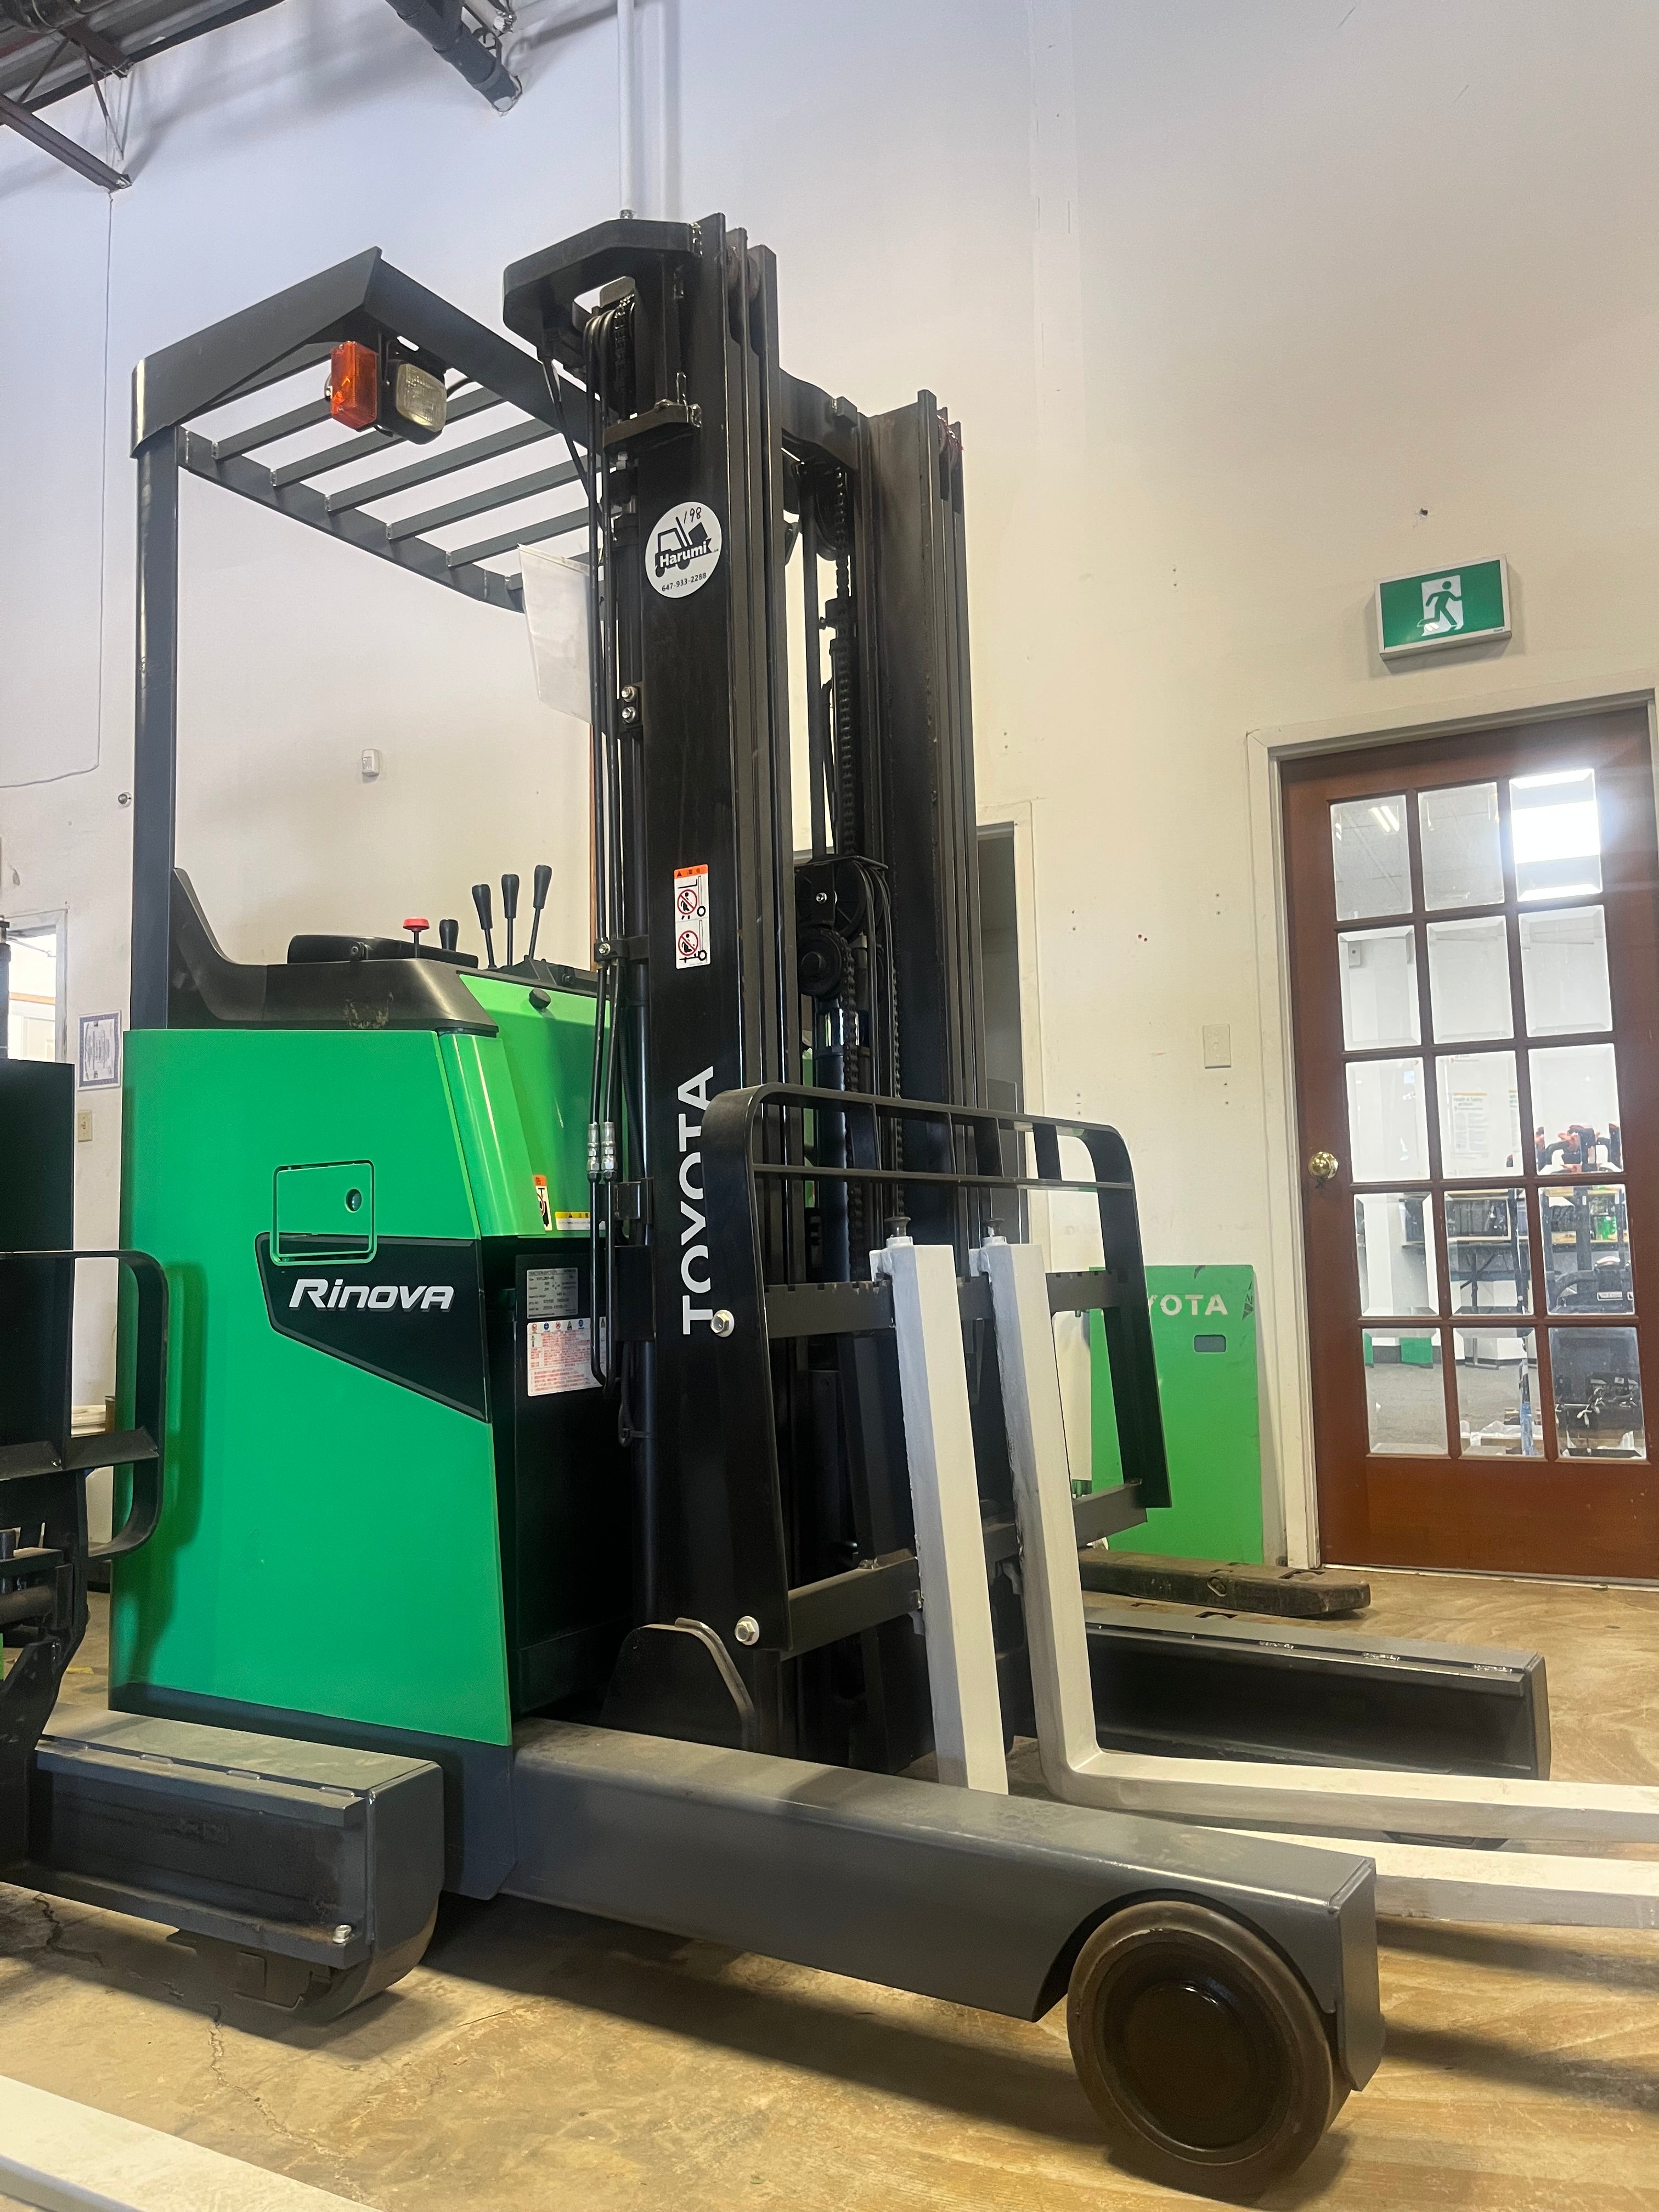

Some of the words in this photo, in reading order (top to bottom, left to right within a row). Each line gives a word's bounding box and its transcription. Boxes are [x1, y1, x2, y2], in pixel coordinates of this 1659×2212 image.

[684, 506, 702, 524] 198
[659, 540, 707, 568] Harumi
[661, 572, 707, 592] 647-933-2288
[678, 1066, 714, 1335] TOYOTA
